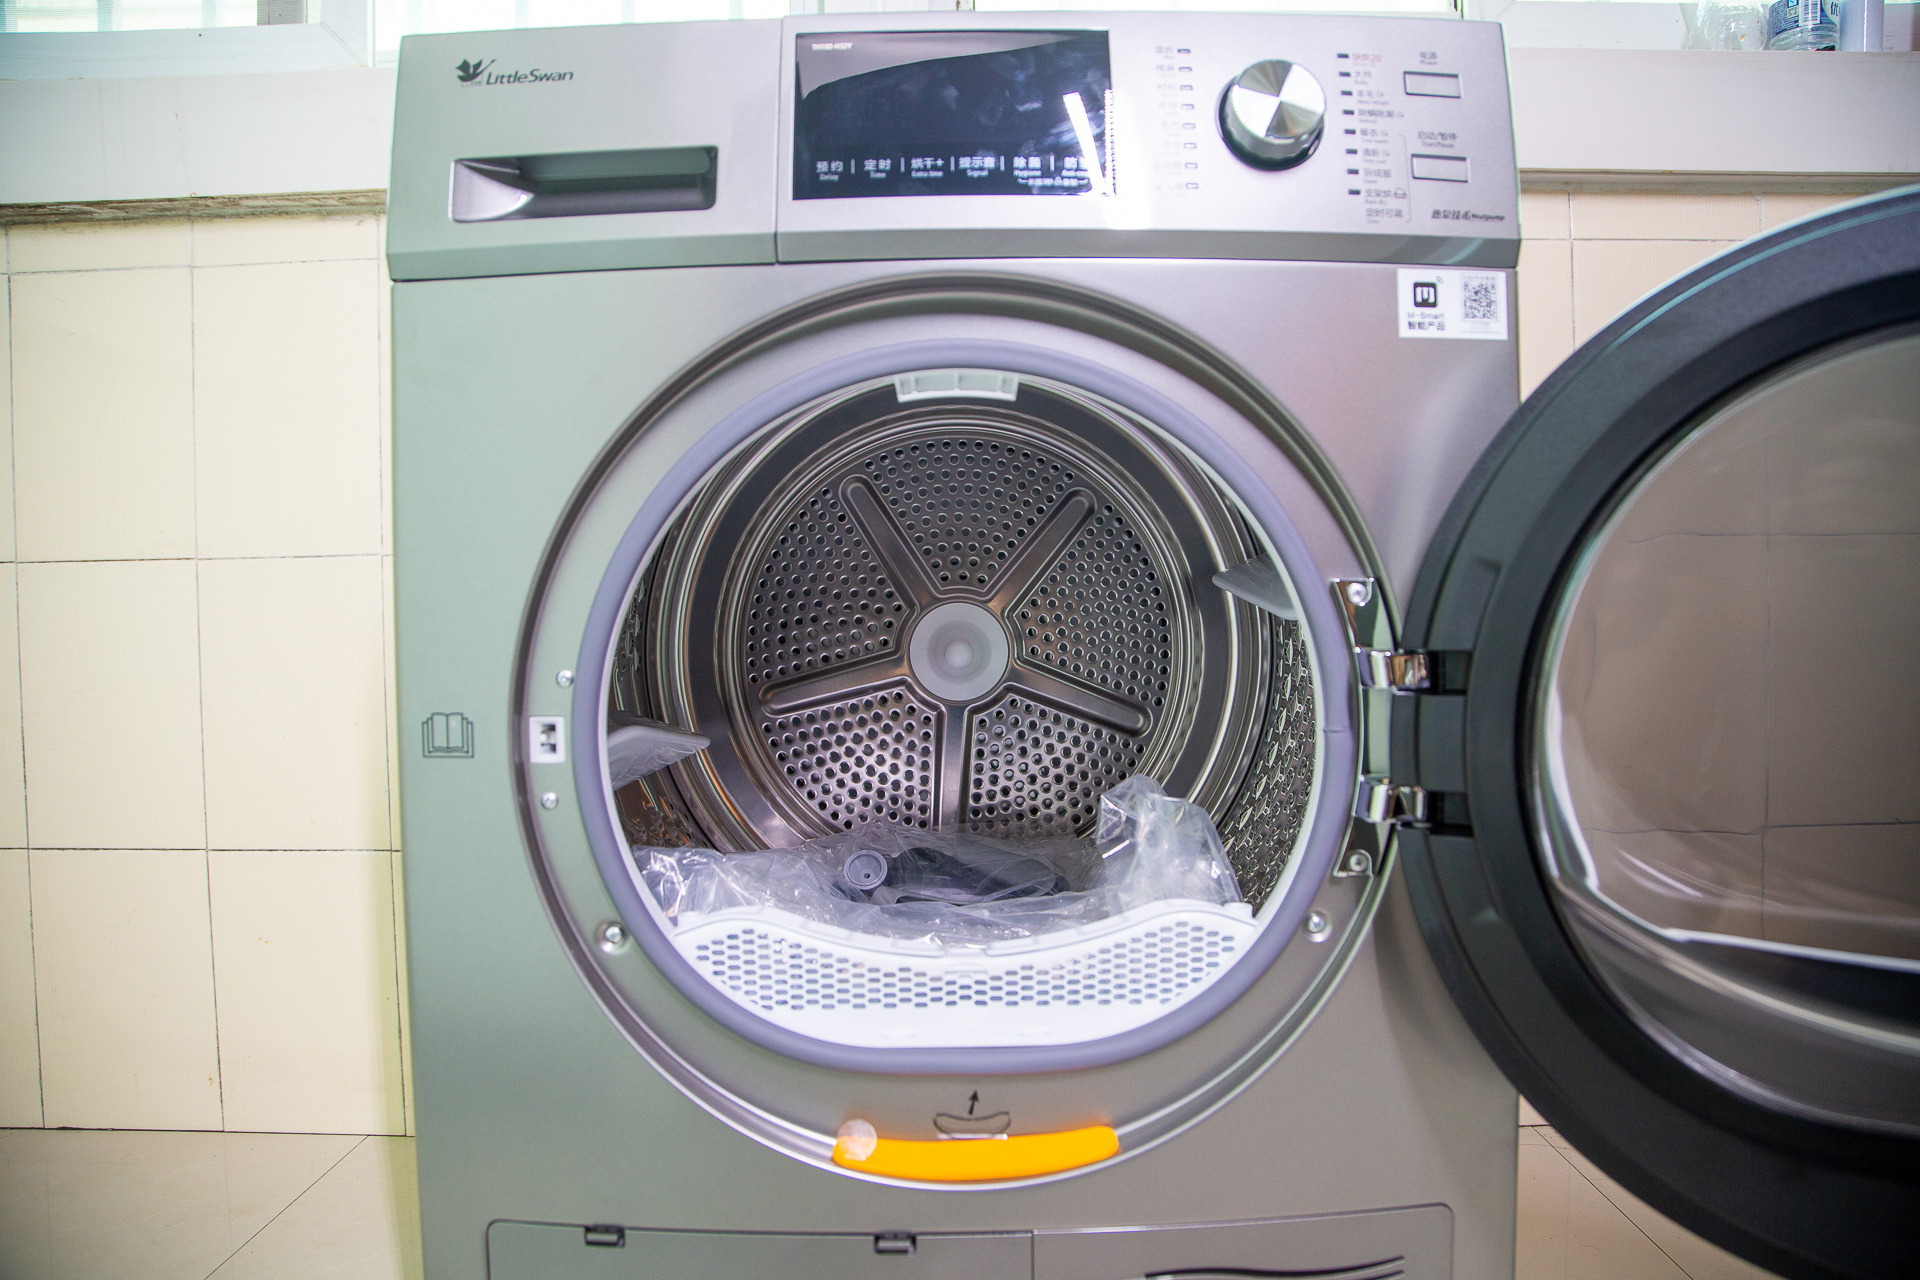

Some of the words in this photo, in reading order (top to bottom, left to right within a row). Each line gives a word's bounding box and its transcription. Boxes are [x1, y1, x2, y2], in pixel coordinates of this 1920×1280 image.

[486, 68, 574, 85] LittleSwan
[816, 160, 844, 173] 预约
[864, 158, 891, 171] 定时
[958, 156, 995, 169] 提示音
[1407, 311, 1445, 320] M-Smart
[1407, 321, 1446, 331] 智能产品
